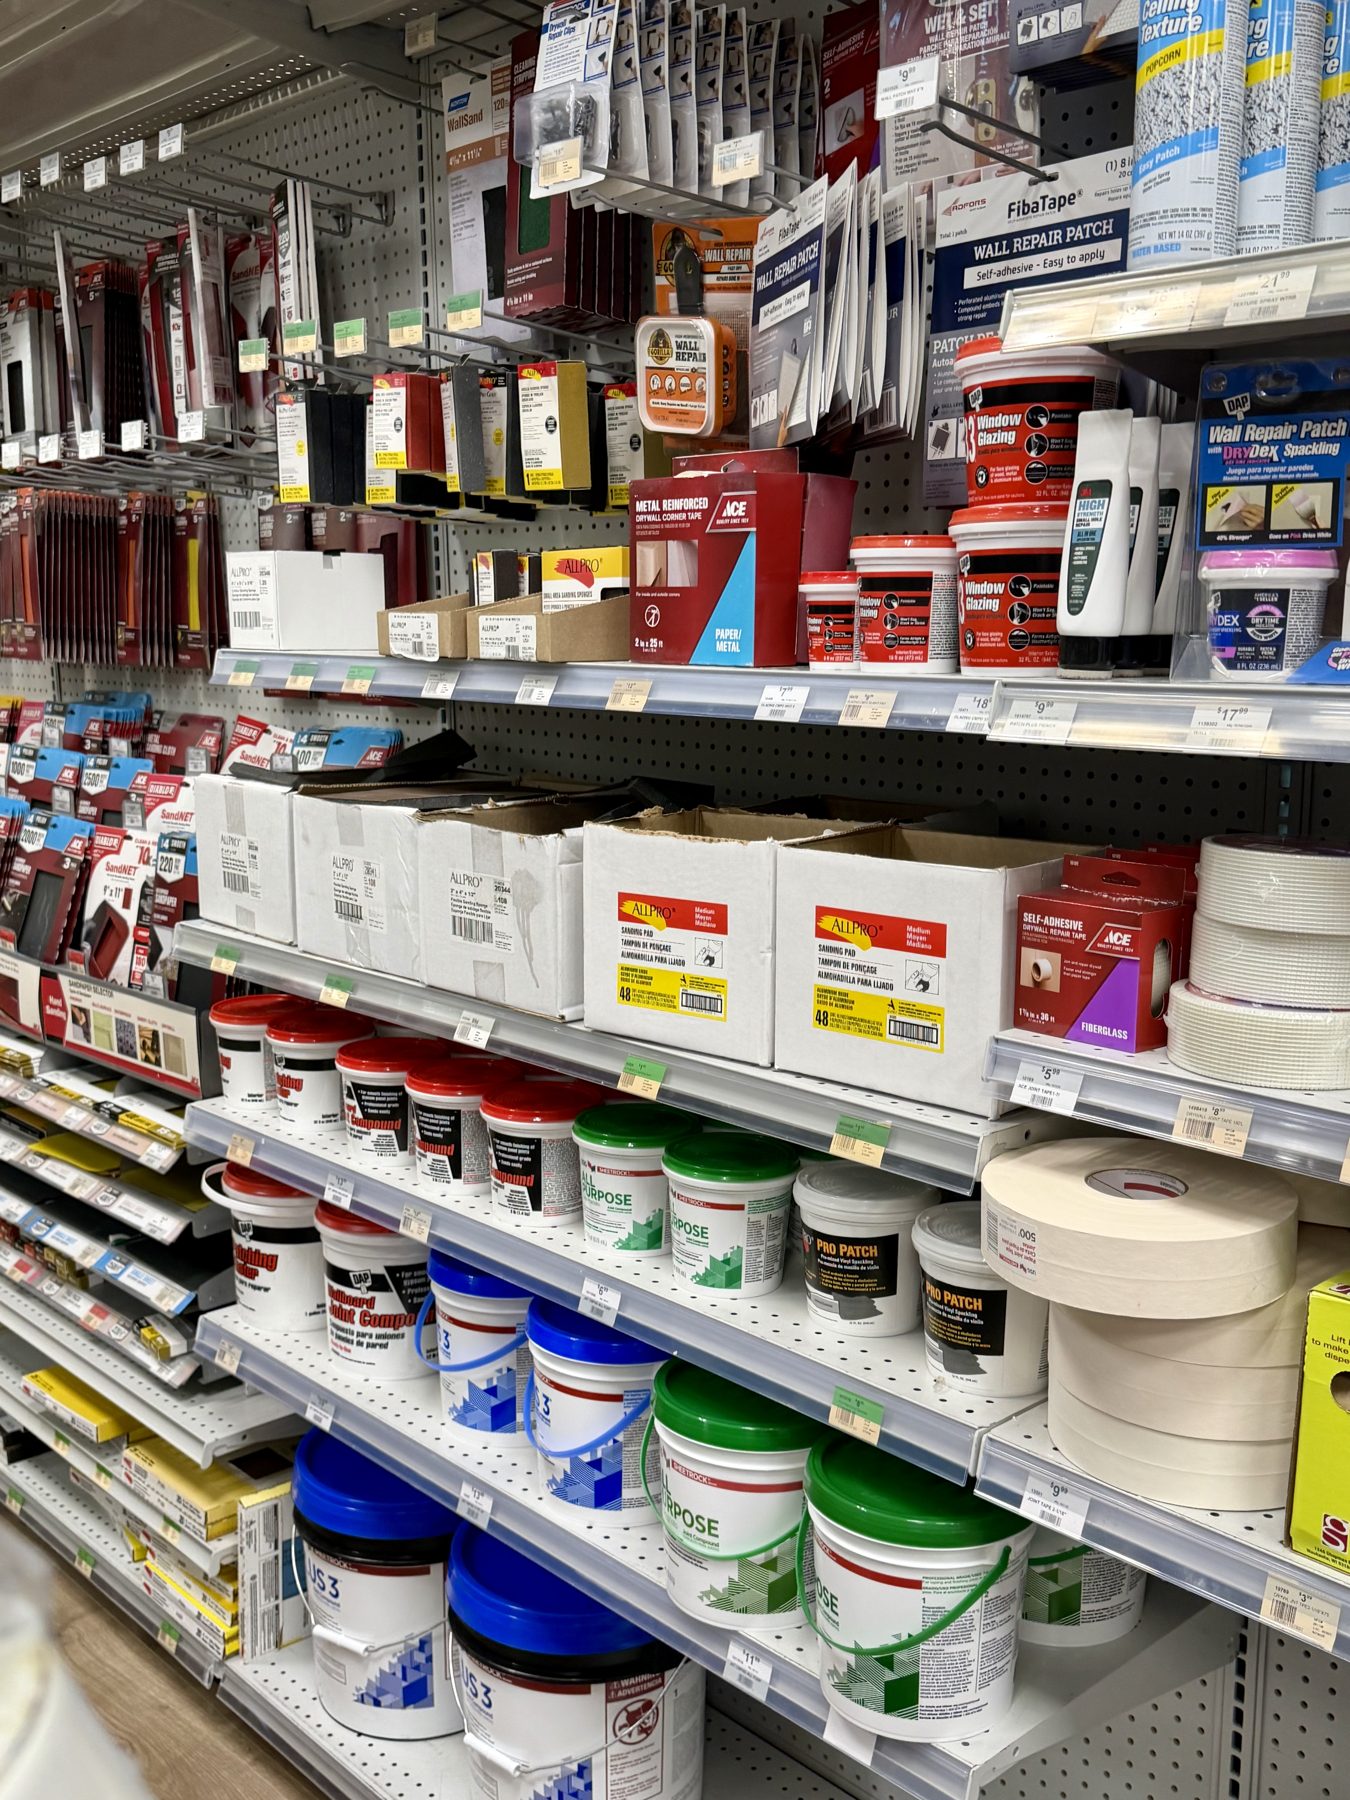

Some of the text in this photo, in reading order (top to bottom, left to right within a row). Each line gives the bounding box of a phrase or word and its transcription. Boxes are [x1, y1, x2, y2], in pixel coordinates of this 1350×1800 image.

[924, 11, 953, 35] WET
[969, 2, 993, 21] SET
[564, 26, 576, 36] Clips
[969, 21, 989, 33] PATCH
[1140, 13, 1203, 46] Texture
[919, 42, 942, 54] PARCHE
[1145, 48, 1182, 76] POPCORN
[824, 78, 831, 94] 2
[493, 98, 505, 111] 120
[448, 109, 483, 132] WallSand
[1105, 158, 1126, 174] (1) 8
[1138, 145, 1180, 175] Easy Patch
[974, 218, 1114, 261] WALL REPAIR PATCH
[1157, 231, 1167, 241] NET
[1168, 230, 1177, 240] WT
[1177, 230, 1184, 240] 14
[1185, 230, 1193, 239] OZ
[704, 247, 750, 261] WALL REPAIR
[1153, 242, 1181, 254] BASED
[756, 240, 819, 292] WALL REPAIR PATCH
[976, 260, 1034, 282] Self-adhesive
[1043, 256, 1064, 271] Easy
[1066, 253, 1077, 264] to
[1079, 249, 1106, 264] apply
[958, 311, 987, 323] strong repair
[675, 340, 700, 350] WALL
[971, 389, 982, 405] DAP
[1227, 395, 1249, 413] DAP
[977, 412, 1022, 430] Window
[978, 430, 1016, 447] Glazing
[1209, 418, 1349, 445] Wall Repair Patch
[1283, 442, 1341, 458] Spackling
[1226, 464, 1315, 475] Juego para reparar paredes
[636, 496, 709, 513] METAL REINFORCED
[722, 501, 747, 518] ACE
[1078, 499, 1105, 512] HIGH
[636, 511, 702, 523] DRYWALL CORNER TAPE
[965, 581, 1005, 595] Window
[966, 597, 999, 612] Glazing
[1251, 617, 1280, 625] DRY TIME
[715, 629, 742, 640] PAPER/
[649, 637, 658, 648] 25
[716, 641, 741, 652] METAL
[84, 739, 91, 750] 3
[202, 735, 217, 747] ACE
[310, 734, 328, 743] SMOOTH
[240, 750, 270, 768] SandNET
[367, 750, 383, 762] ACE
[62, 767, 75, 779] ACE
[135, 774, 147, 785] ACE
[149, 784, 170, 795] DIABLO
[160, 808, 195, 823] SandNET
[70, 839, 83, 850] ACE
[63, 857, 72, 869] 3
[105, 861, 139, 877] SandNET
[159, 855, 174, 873] 220
[695, 907, 716, 915] Medium
[1023, 912, 1083, 932] SELF-ADHESIVE
[621, 926, 654, 938] SANDING PAD
[907, 925, 931, 936] Medium
[1023, 923, 1048, 935] DRYWALL
[1049, 927, 1070, 938] REPAIR
[1072, 931, 1087, 941] TAPE
[1104, 929, 1132, 946] ACE
[621, 938, 672, 953] TAMPON DE PONÇAGE
[906, 940, 932, 951] Mediano
[907, 933, 927, 944] Moyen
[818, 943, 856, 958] SANDING PAD
[620, 951, 686, 968] ALMOHADILLA PARA LIJADO
[818, 957, 878, 976] TAMPON DE PONÇAGE
[817, 970, 894, 992] ALMOHADILLA PARA LIJADO
[49, 994, 62, 1007] Hand
[619, 986, 631, 1003] 48
[815, 1008, 829, 1027] 48
[1081, 1021, 1128, 1040] FIBERGLASS
[581, 1173, 595, 1188] ALL
[583, 1188, 632, 1206] PURPOSE
[816, 1238, 878, 1258] PRO PATCH
[840, 1257, 852, 1265] Vinyl
[852, 1258, 874, 1266] Spackling
[353, 1272, 371, 1285] DAP
[925, 1280, 983, 1312] PRO PATCH
[955, 1308, 978, 1319] Spackling
[356, 1328, 405, 1341] para uniones
[442, 1328, 452, 1350] 3
[1331, 1334, 1346, 1345] Lift
[356, 1337, 389, 1350] de pared
[1311, 1337, 1349, 1355] to make
[1325, 1352, 1350, 1365] dispe
[542, 1394, 553, 1417] 3
[673, 1460, 711, 1484] SHEETROCK
[1027, 1496, 1052, 1511] JOINT TAPE
[693, 1532, 720, 1548] Compound
[328, 1575, 340, 1600] 3
[617, 1677, 662, 1697] ADVERTENCIA
[481, 1681, 493, 1709] 3
